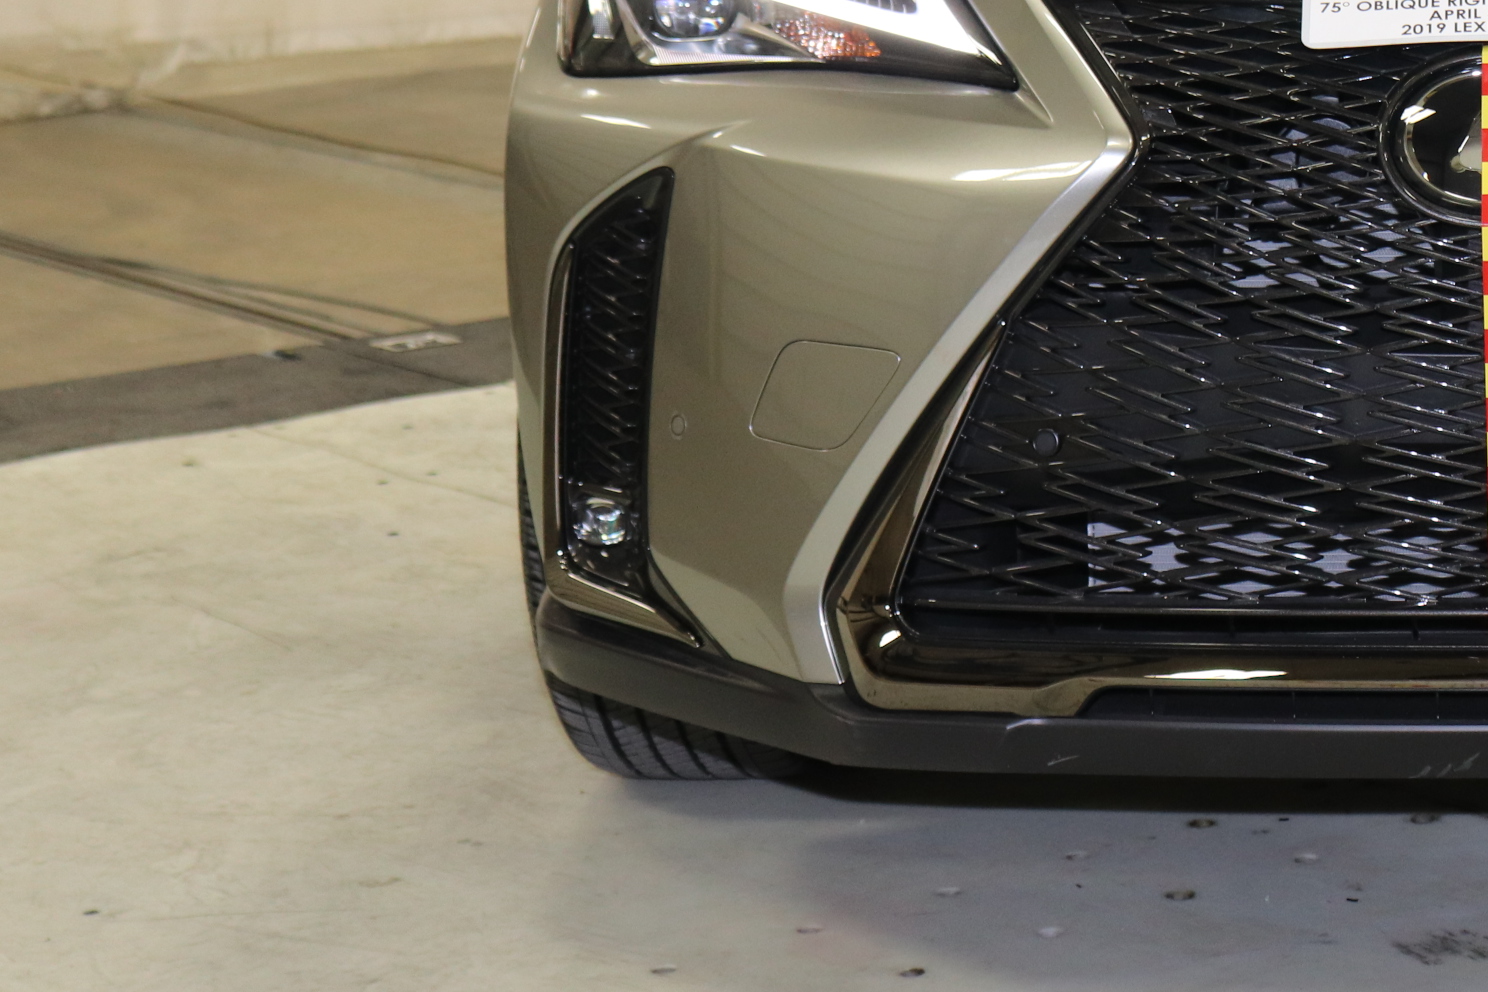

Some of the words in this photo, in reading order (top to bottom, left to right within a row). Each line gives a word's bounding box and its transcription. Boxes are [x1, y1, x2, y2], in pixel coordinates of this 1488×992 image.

[1320, 1, 1351, 13] 75°
[1429, 8, 1482, 21] APRIL
[1401, 22, 1446, 35] 2019
